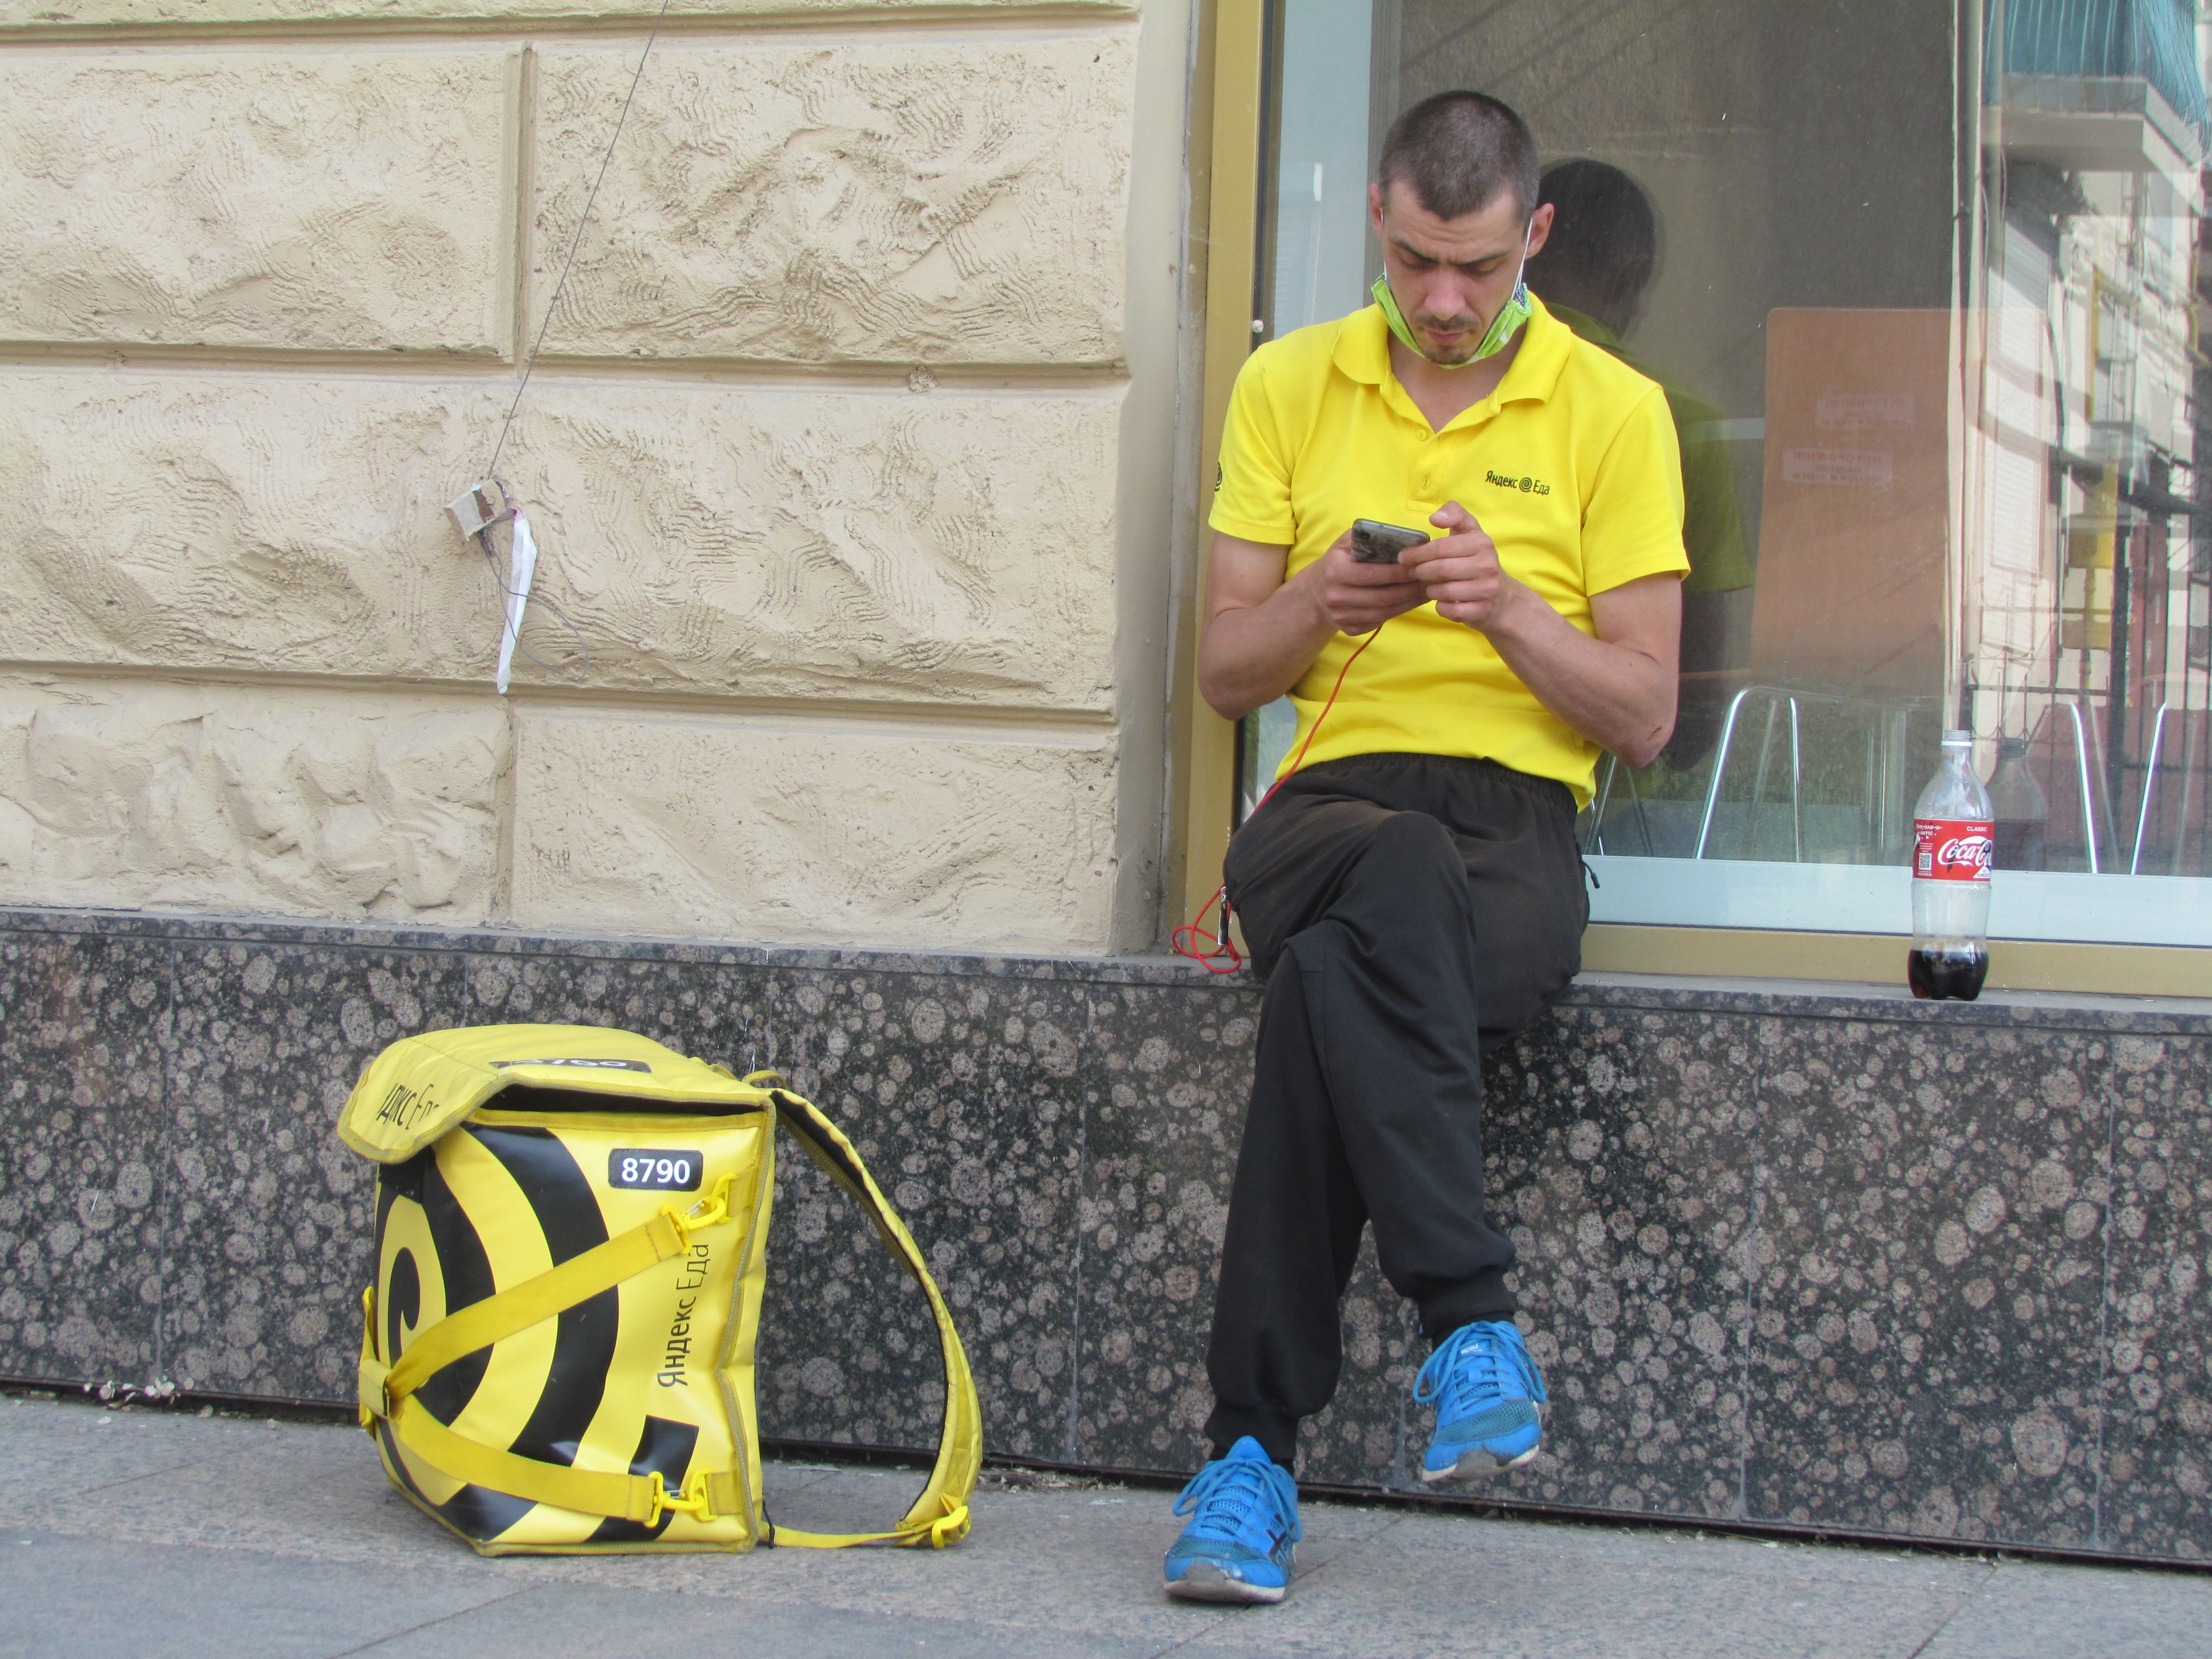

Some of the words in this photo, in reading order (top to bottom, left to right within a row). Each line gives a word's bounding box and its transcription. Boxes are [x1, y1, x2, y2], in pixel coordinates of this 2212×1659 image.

[1485, 470, 1518, 488] Яндекс
[1533, 480, 1550, 496] Еда
[621, 1157, 690, 1184] 8790
[675, 1244, 711, 1290] Еда
[656, 1296, 696, 1388] Яндекс
